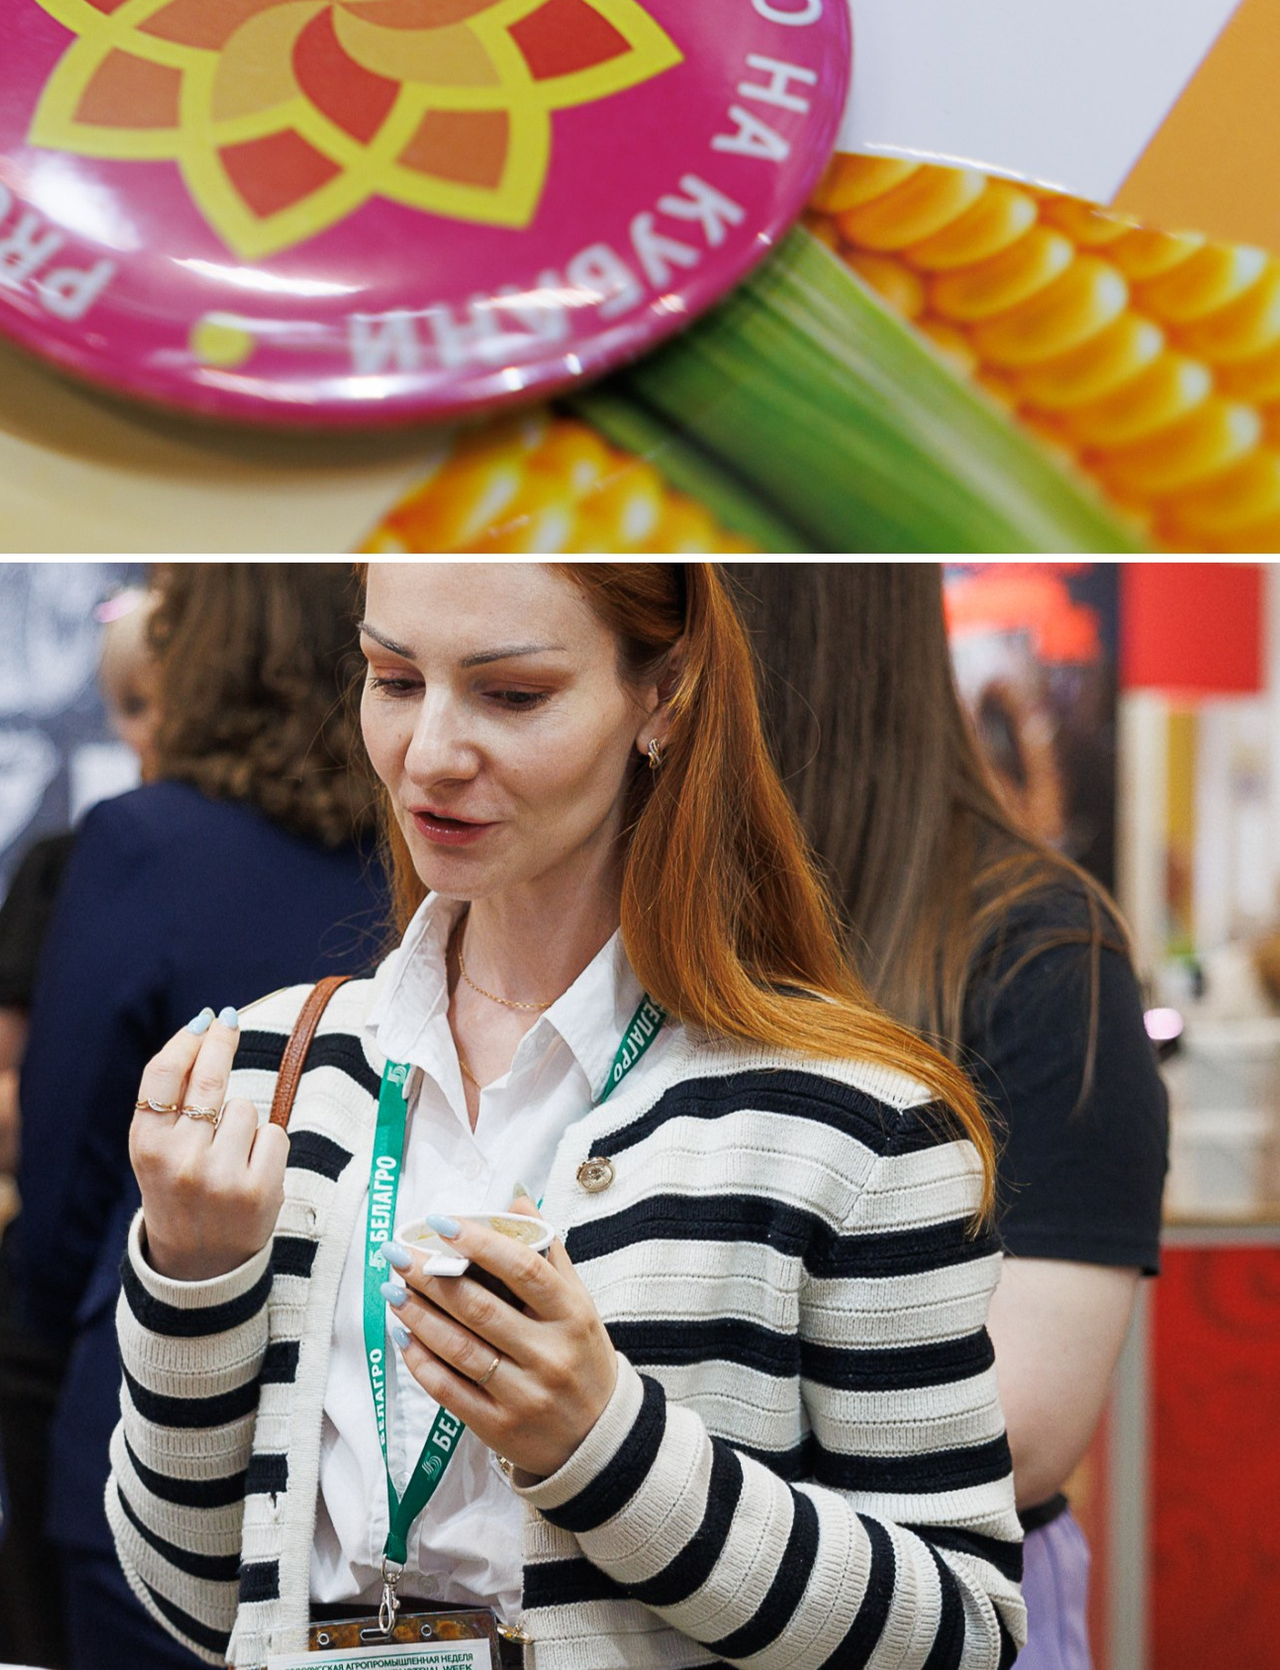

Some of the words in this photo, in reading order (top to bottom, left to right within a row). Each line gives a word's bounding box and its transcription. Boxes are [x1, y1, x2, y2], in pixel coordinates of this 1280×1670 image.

[710, 51, 818, 161] НА
[349, 173, 746, 374] КУБАНИ
[613, 1001, 661, 1083] ЕЛАГРО
[369, 1155, 398, 1243] БЕЛАГРО
[345, 1655, 440, 1670] АГРОПРОМЫШЛЕННАЯ
[440, 1653, 474, 1664] НЕДЕЛЯ
